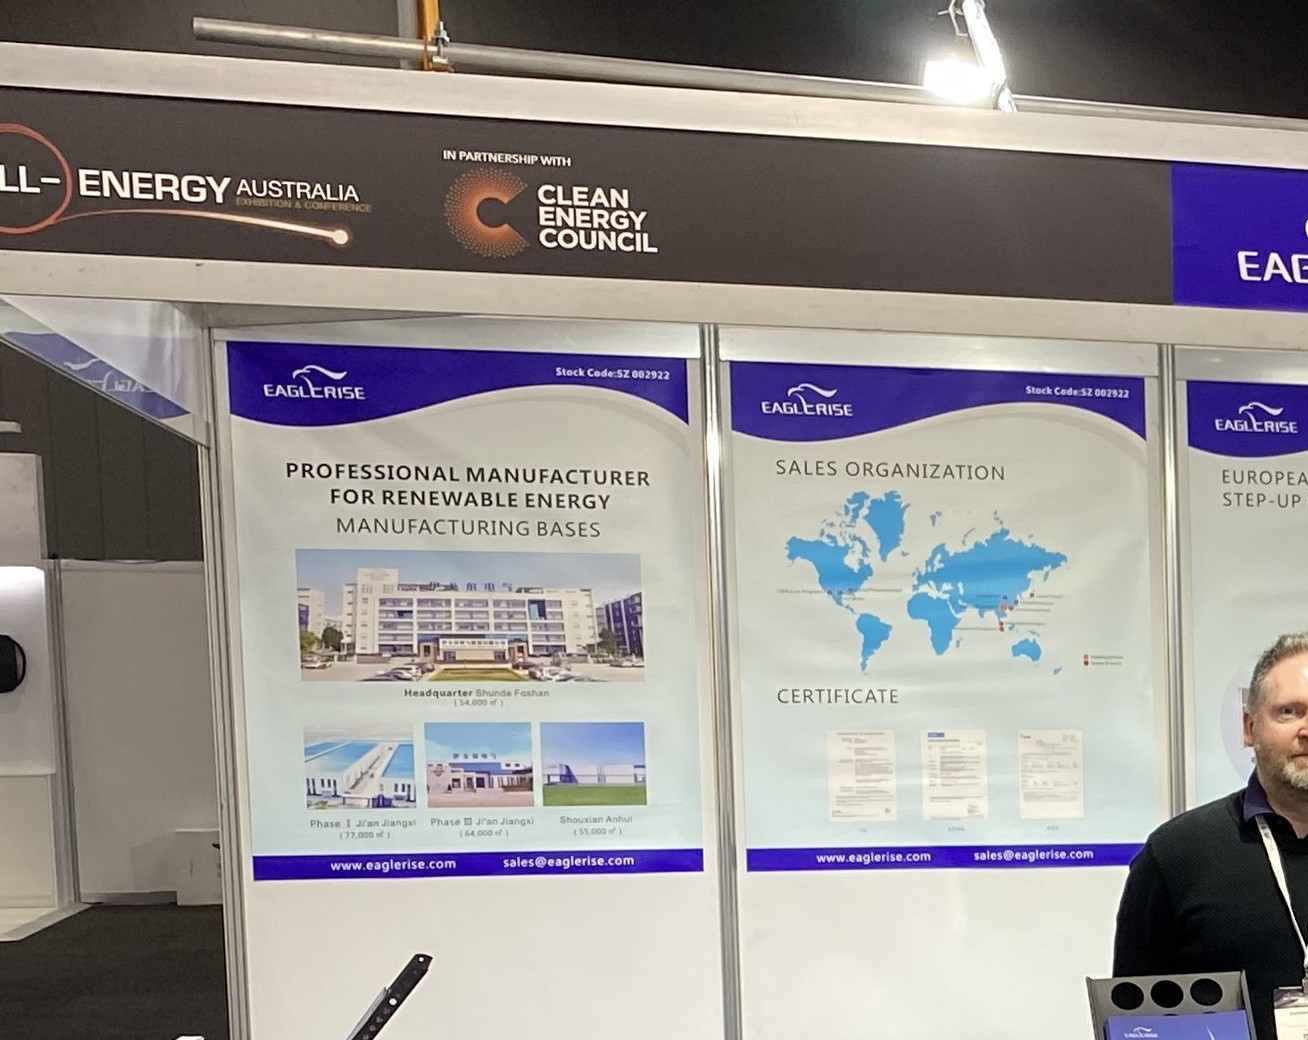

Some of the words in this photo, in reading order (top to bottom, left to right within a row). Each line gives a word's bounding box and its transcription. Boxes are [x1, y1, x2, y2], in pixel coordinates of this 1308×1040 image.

[442, 150, 457, 160] IN
[459, 151, 538, 165] PARTNERSHIP
[540, 156, 571, 167] WITH
[0, 164, 60, 194] LL-
[78, 168, 231, 204] ENERGY
[236, 179, 359, 202] AUSTRALIA
[537, 184, 629, 209] CLEAN
[539, 206, 647, 230] ENERGY
[539, 228, 659, 253] COUNCIL
[555, 367, 584, 379] Stock
[586, 368, 629, 380] Code:SZ
[631, 369, 670, 380] 002922
[263, 384, 367, 401] EAGLERISE
[1025, 385, 1052, 396] Stock
[1054, 386, 1092, 397] Code:SZ
[1094, 388, 1129, 398] 002922
[761, 401, 854, 417] EAGLERISE
[1215, 419, 1298, 434] EAGLERISE
[285, 462, 460, 484] PROFESSIONAL
[466, 467, 650, 487] MANUFACTURER
[776, 459, 838, 477] SALES
[845, 461, 1006, 481] ORGANIZATION
[330, 488, 375, 505] FOR
[381, 490, 518, 508] RENEWABLE
[525, 492, 610, 510] ENERGY
[1223, 492, 1302, 509] STEP-UP
[336, 518, 530, 537] MANUFACTURING
[537, 521, 601, 538] BASES
[404, 688, 473, 699] Headquarter
[475, 688, 512, 697] Shunde
[514, 688, 550, 697] Foshan
[776, 688, 899, 705] CERTIFICATE
[310, 819, 341, 829] Phase
[430, 818, 461, 826] Phase
[330, 858, 457, 872] www.eaglerise.com
[503, 855, 634, 870] sales@eaglerise.com
[816, 850, 931, 865] www.eaglerise.com
[973, 847, 1094, 862] sales@eaglerise.com
